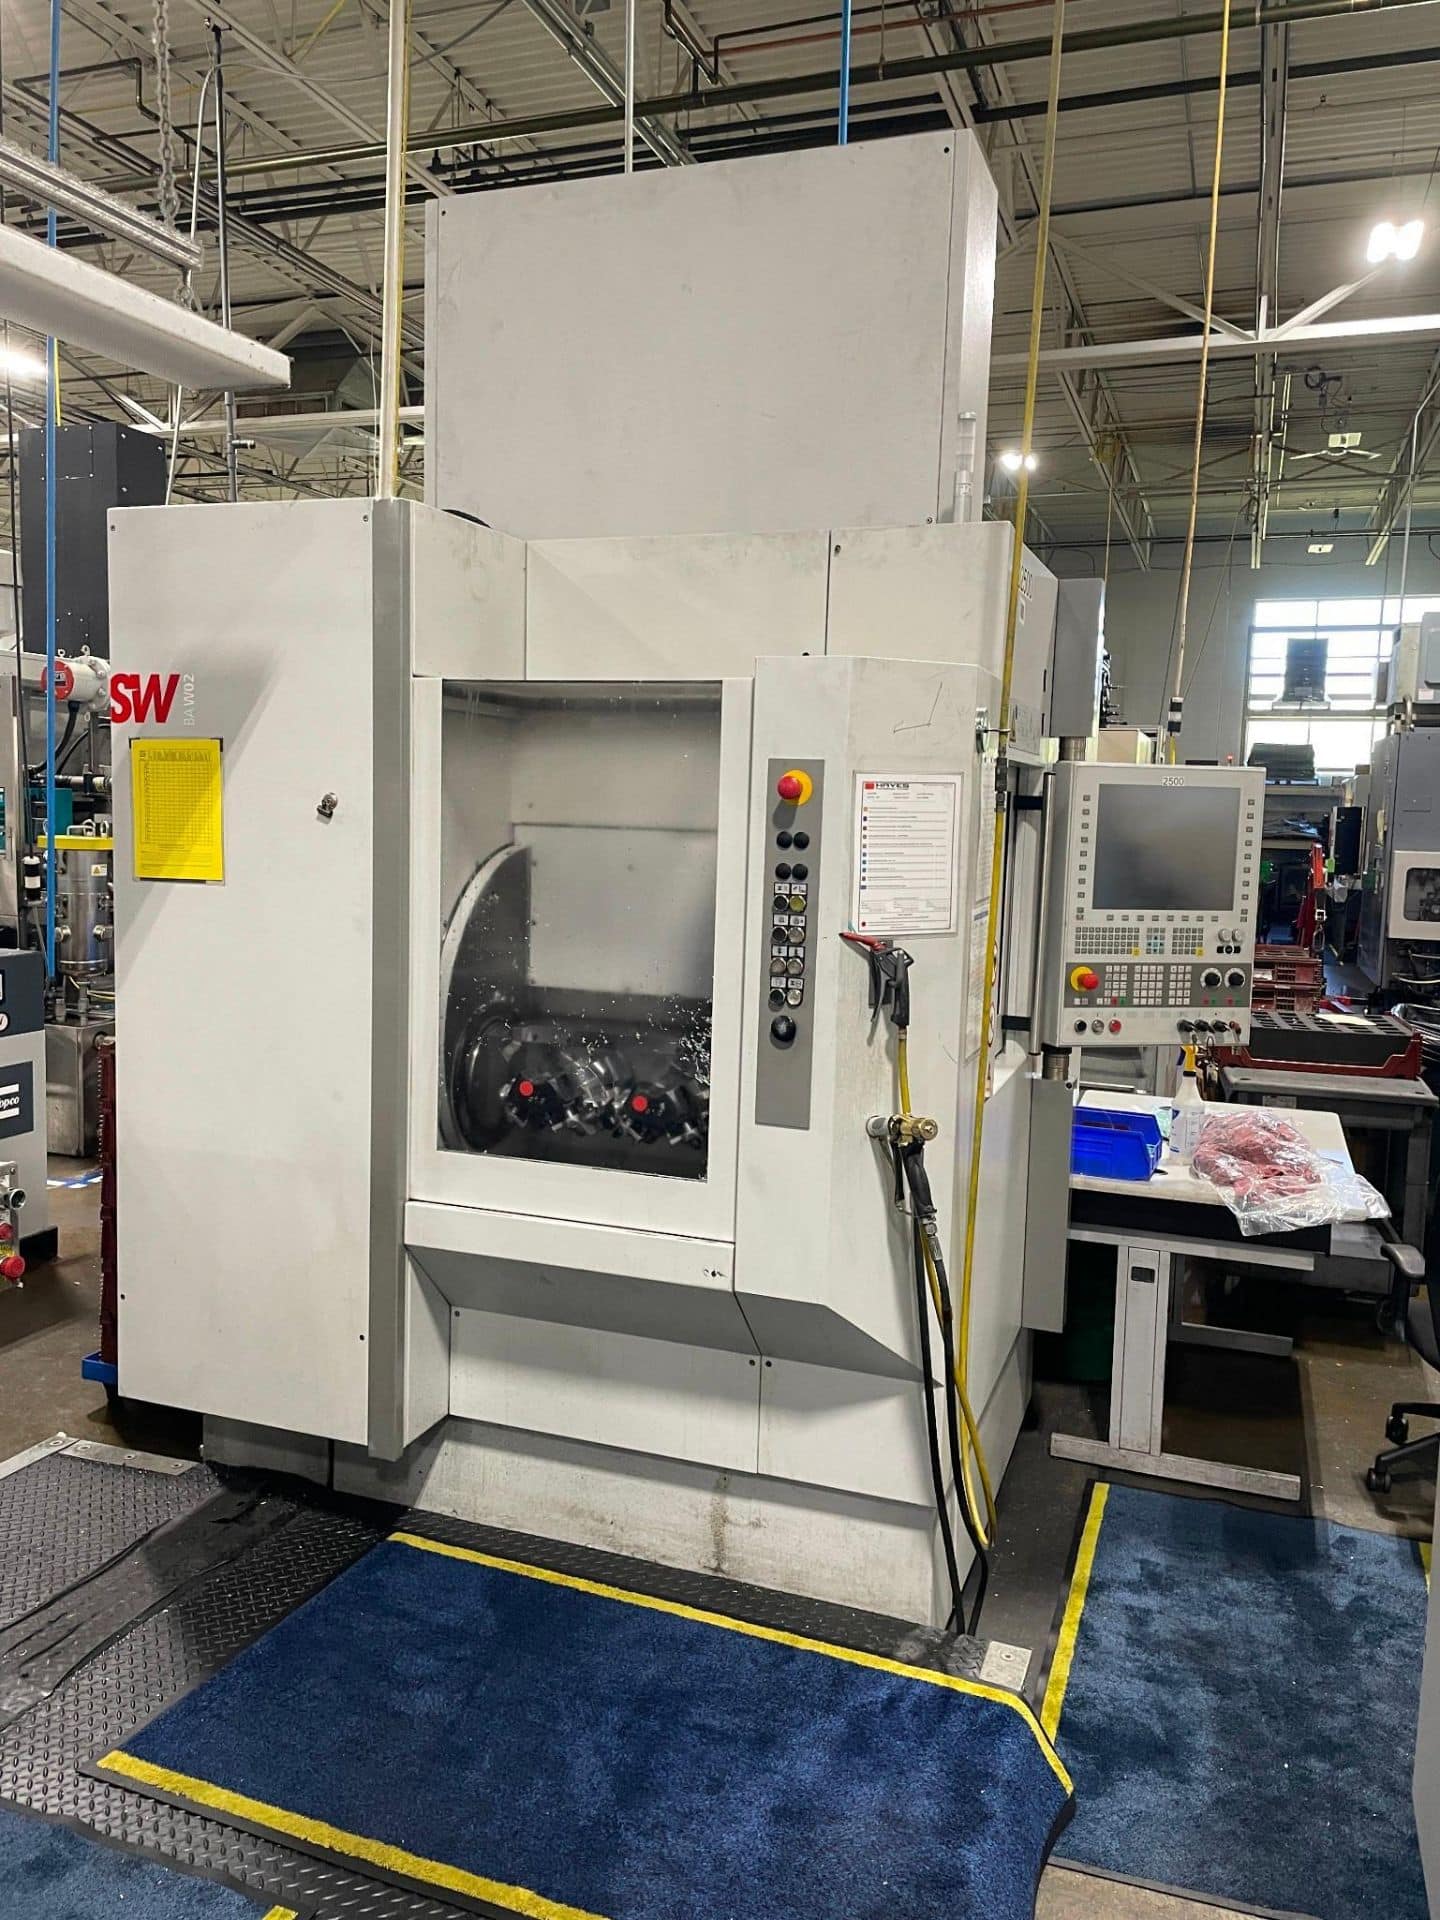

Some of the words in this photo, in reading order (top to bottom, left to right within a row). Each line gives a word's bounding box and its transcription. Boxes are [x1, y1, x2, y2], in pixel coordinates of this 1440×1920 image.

[111, 673, 180, 724] SW
[183, 672, 195, 706] W02
[1162, 776, 1184, 786] 2500
